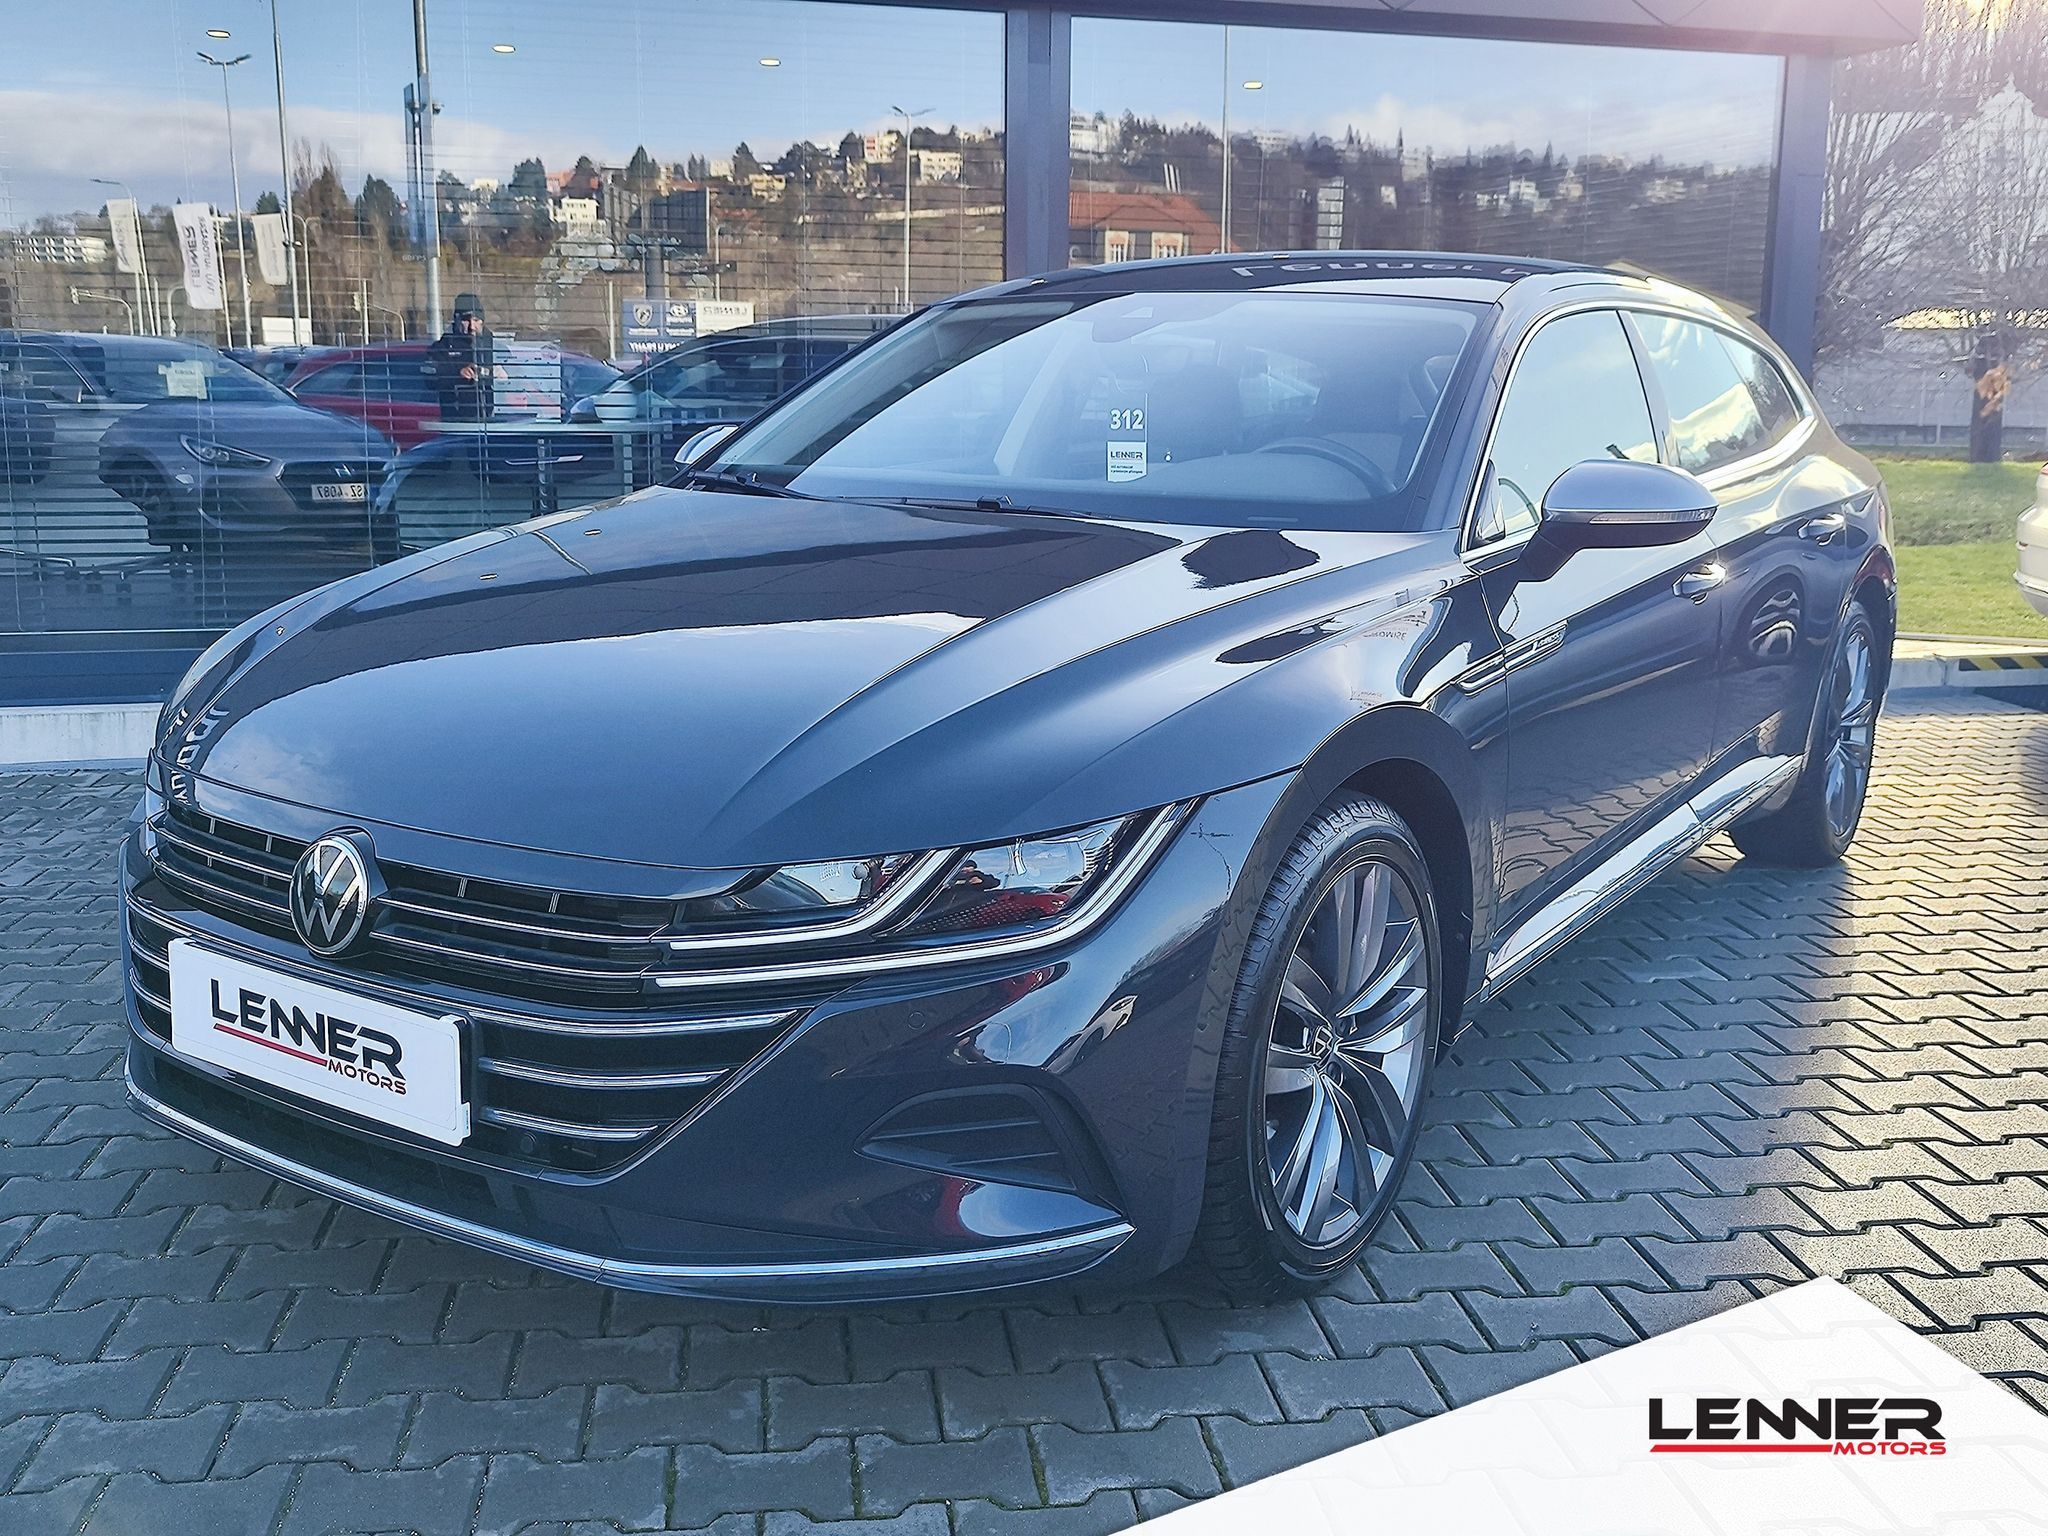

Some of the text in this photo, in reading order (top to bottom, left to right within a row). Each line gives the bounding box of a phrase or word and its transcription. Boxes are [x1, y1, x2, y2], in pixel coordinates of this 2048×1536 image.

[1110, 408, 1144, 431] 312
[1110, 451, 1143, 460] LENNER
[211, 978, 406, 1080] LENNER
[328, 1058, 407, 1096] MOTORS
